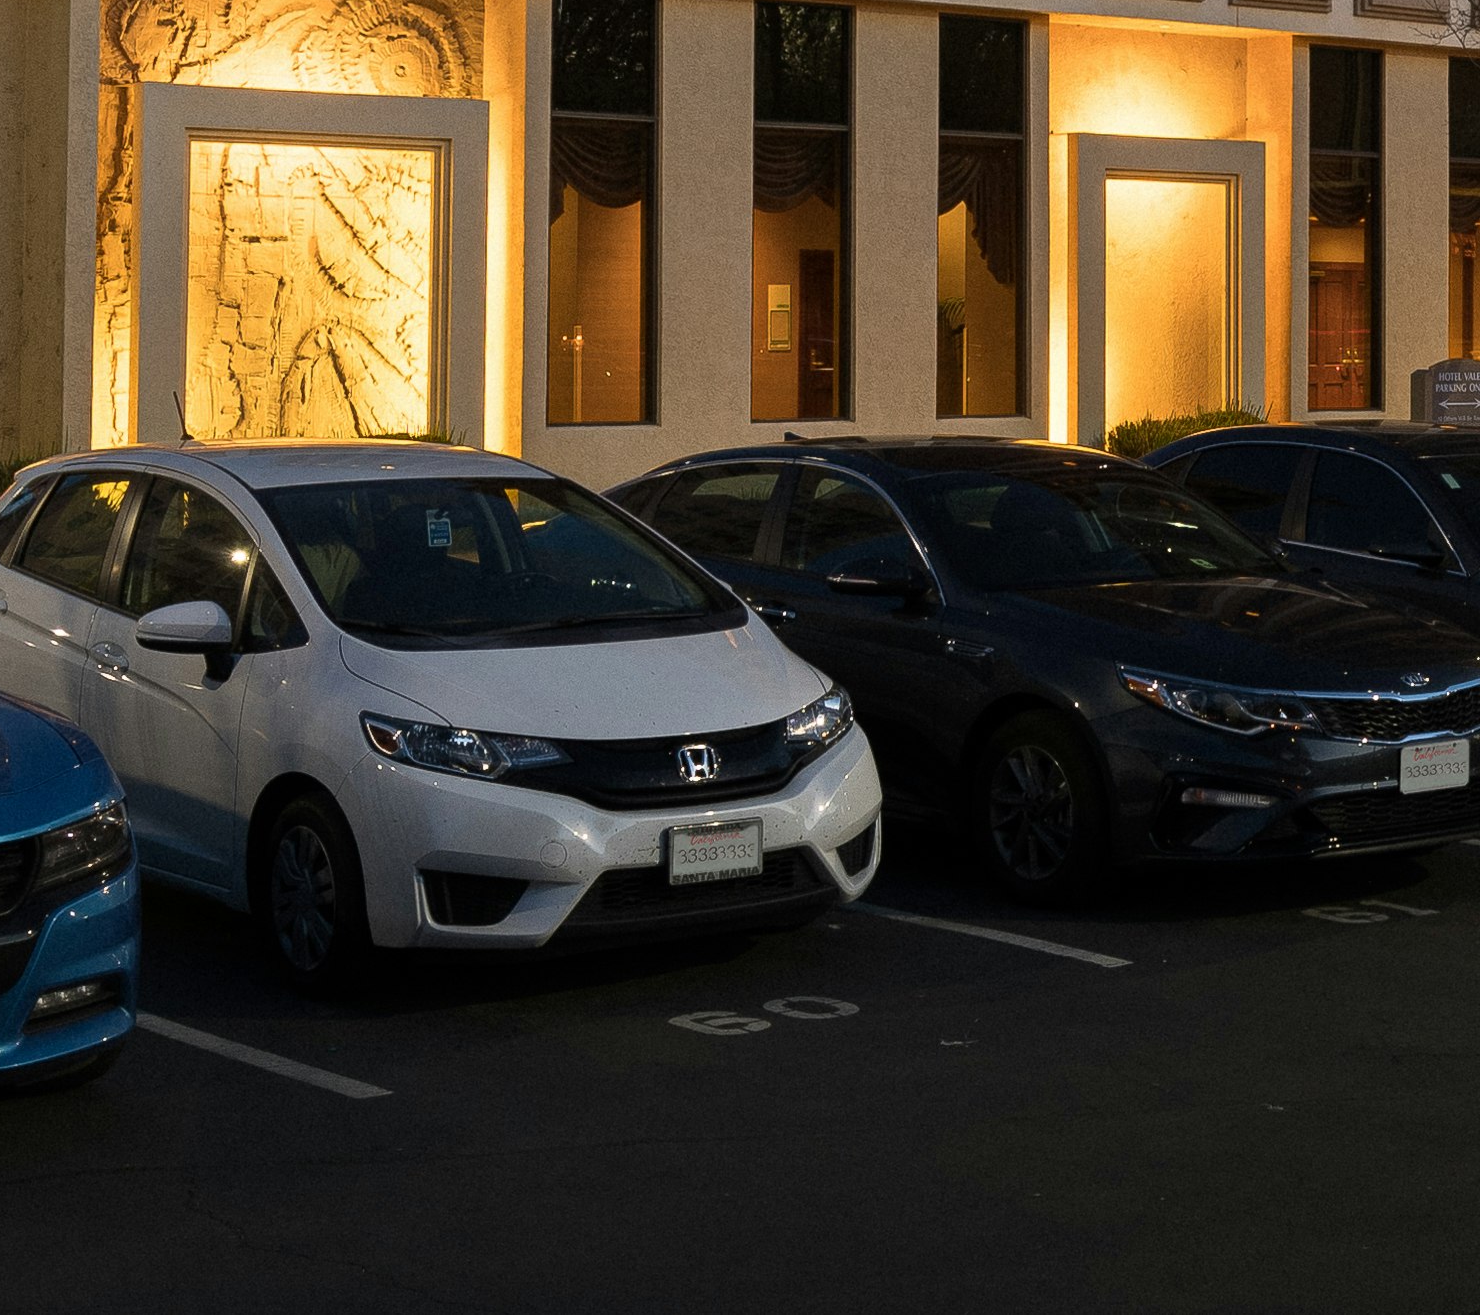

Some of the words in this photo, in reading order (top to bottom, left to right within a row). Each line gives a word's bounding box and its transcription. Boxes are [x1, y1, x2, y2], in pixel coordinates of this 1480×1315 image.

[1438, 372, 1462, 381] HOTEL
[1435, 383, 1467, 393] PARKING
[672, 871, 715, 884] SANTA
[719, 866, 760, 880] MARIA
[1301, 899, 1440, 924] 61
[667, 995, 861, 1036] 60
